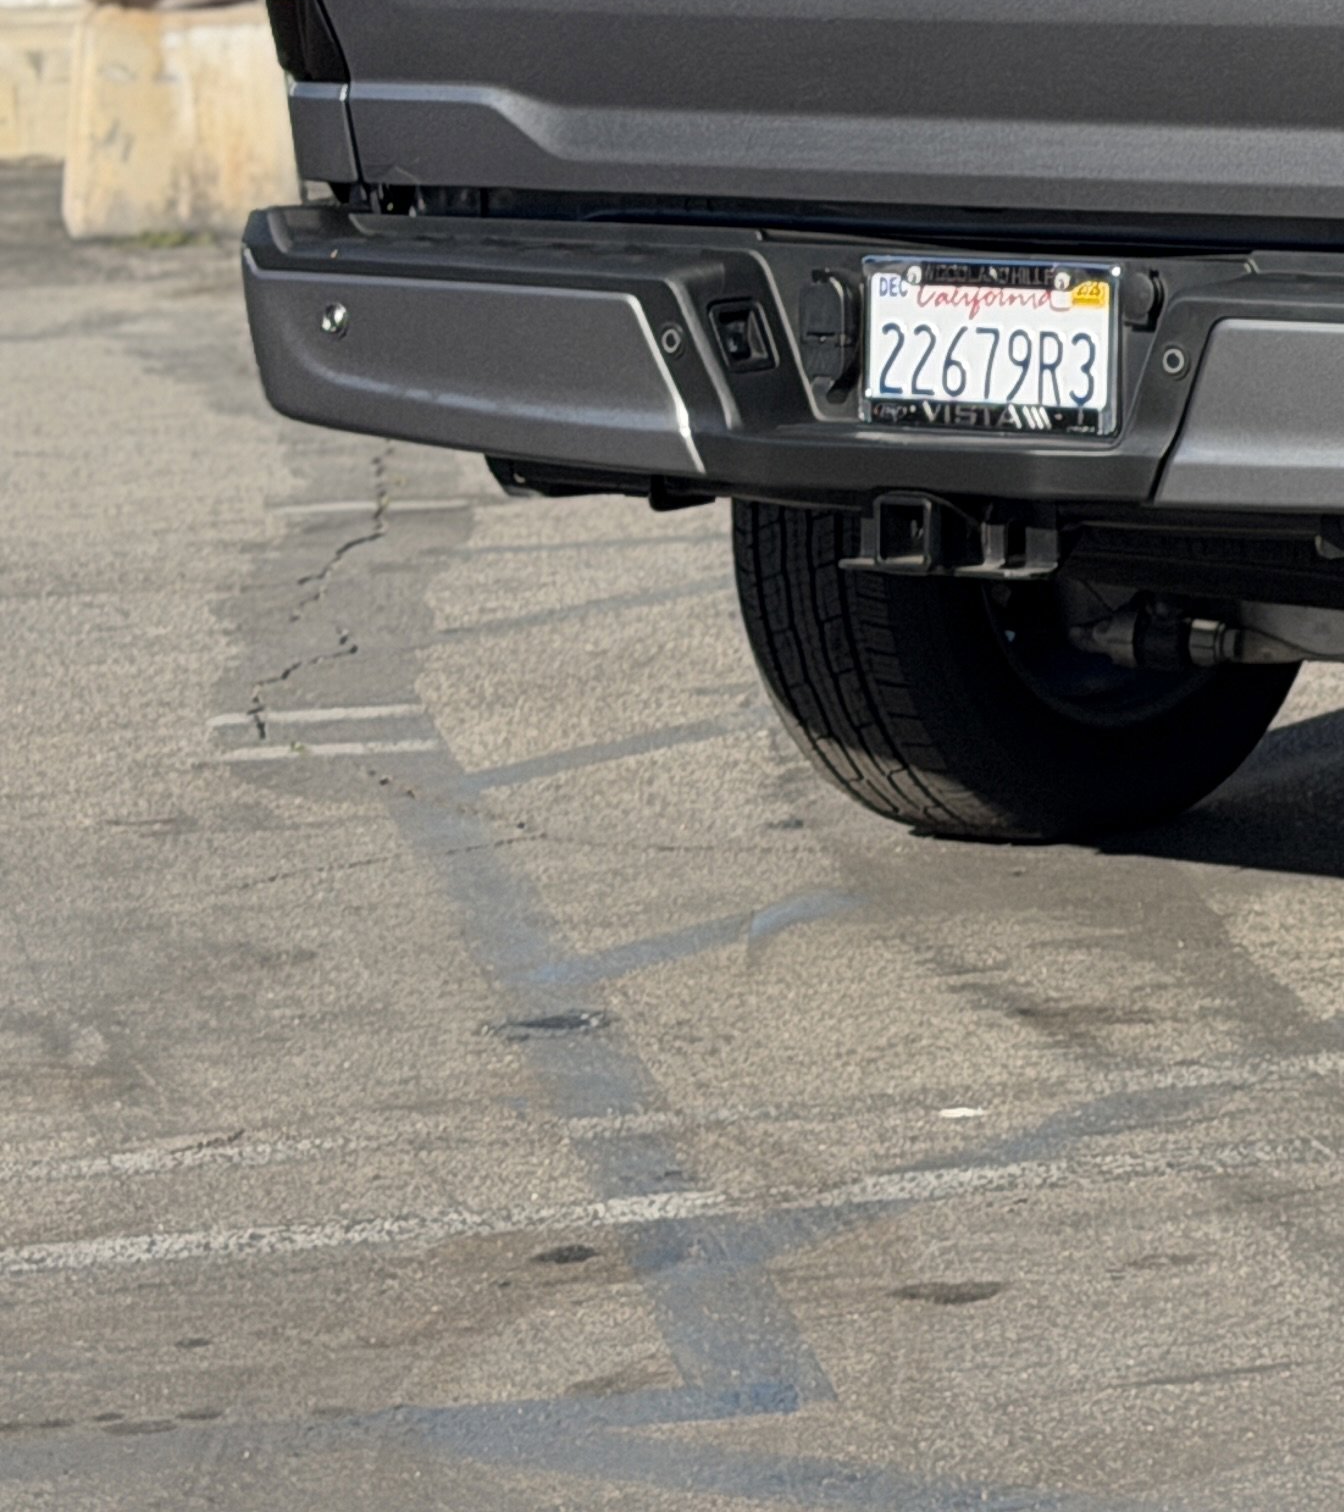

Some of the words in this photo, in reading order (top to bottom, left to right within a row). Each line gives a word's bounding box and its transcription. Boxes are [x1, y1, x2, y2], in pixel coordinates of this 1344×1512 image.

[879, 276, 908, 297] DEC
[917, 285, 1052, 320] California
[879, 322, 1097, 405] 22679R3
[921, 399, 1022, 430] VISTA
